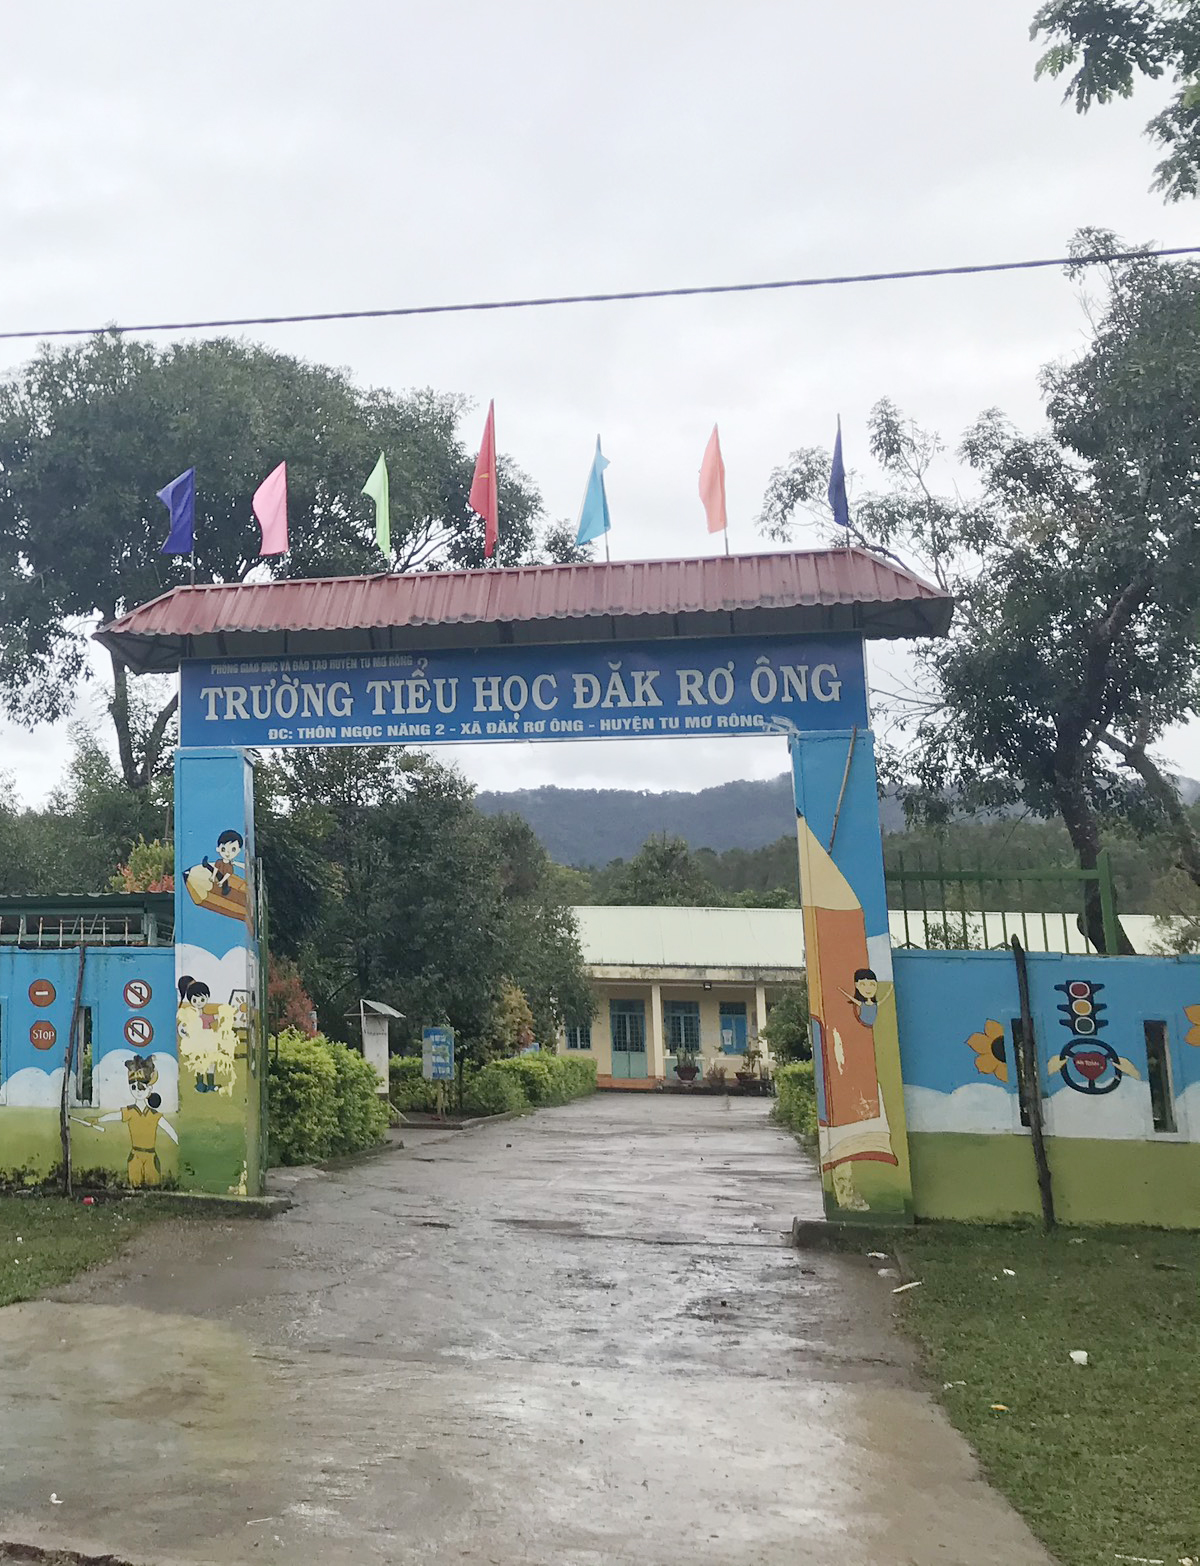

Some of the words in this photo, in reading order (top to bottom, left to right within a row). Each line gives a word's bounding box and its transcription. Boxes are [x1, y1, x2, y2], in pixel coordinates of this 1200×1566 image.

[211, 662, 239, 675] PHÒNG
[200, 674, 354, 721] TRƯỜNG
[366, 657, 458, 716] TIỂU
[472, 674, 558, 720] HỌC
[572, 660, 663, 709] ĐĂK
[676, 660, 736, 706] RƠ
[750, 655, 843, 704] ÔNG
[268, 727, 293, 740] ĐC:
[297, 725, 338, 740] THÔN
[341, 725, 383, 740] NGỌC
[387, 722, 431, 737] NĂNG
[435, 723, 445, 736] 2
[461, 718, 482, 734] XÃ
[524, 718, 546, 733] RƠ
[550, 716, 584, 733] ÔNG
[600, 714, 655, 733] HUYỆN
[659, 716, 680, 729] TU
[685, 714, 714, 728] MƠ
[718, 712, 764, 728] RÔNG
[32, 1030, 55, 1040] STOP
